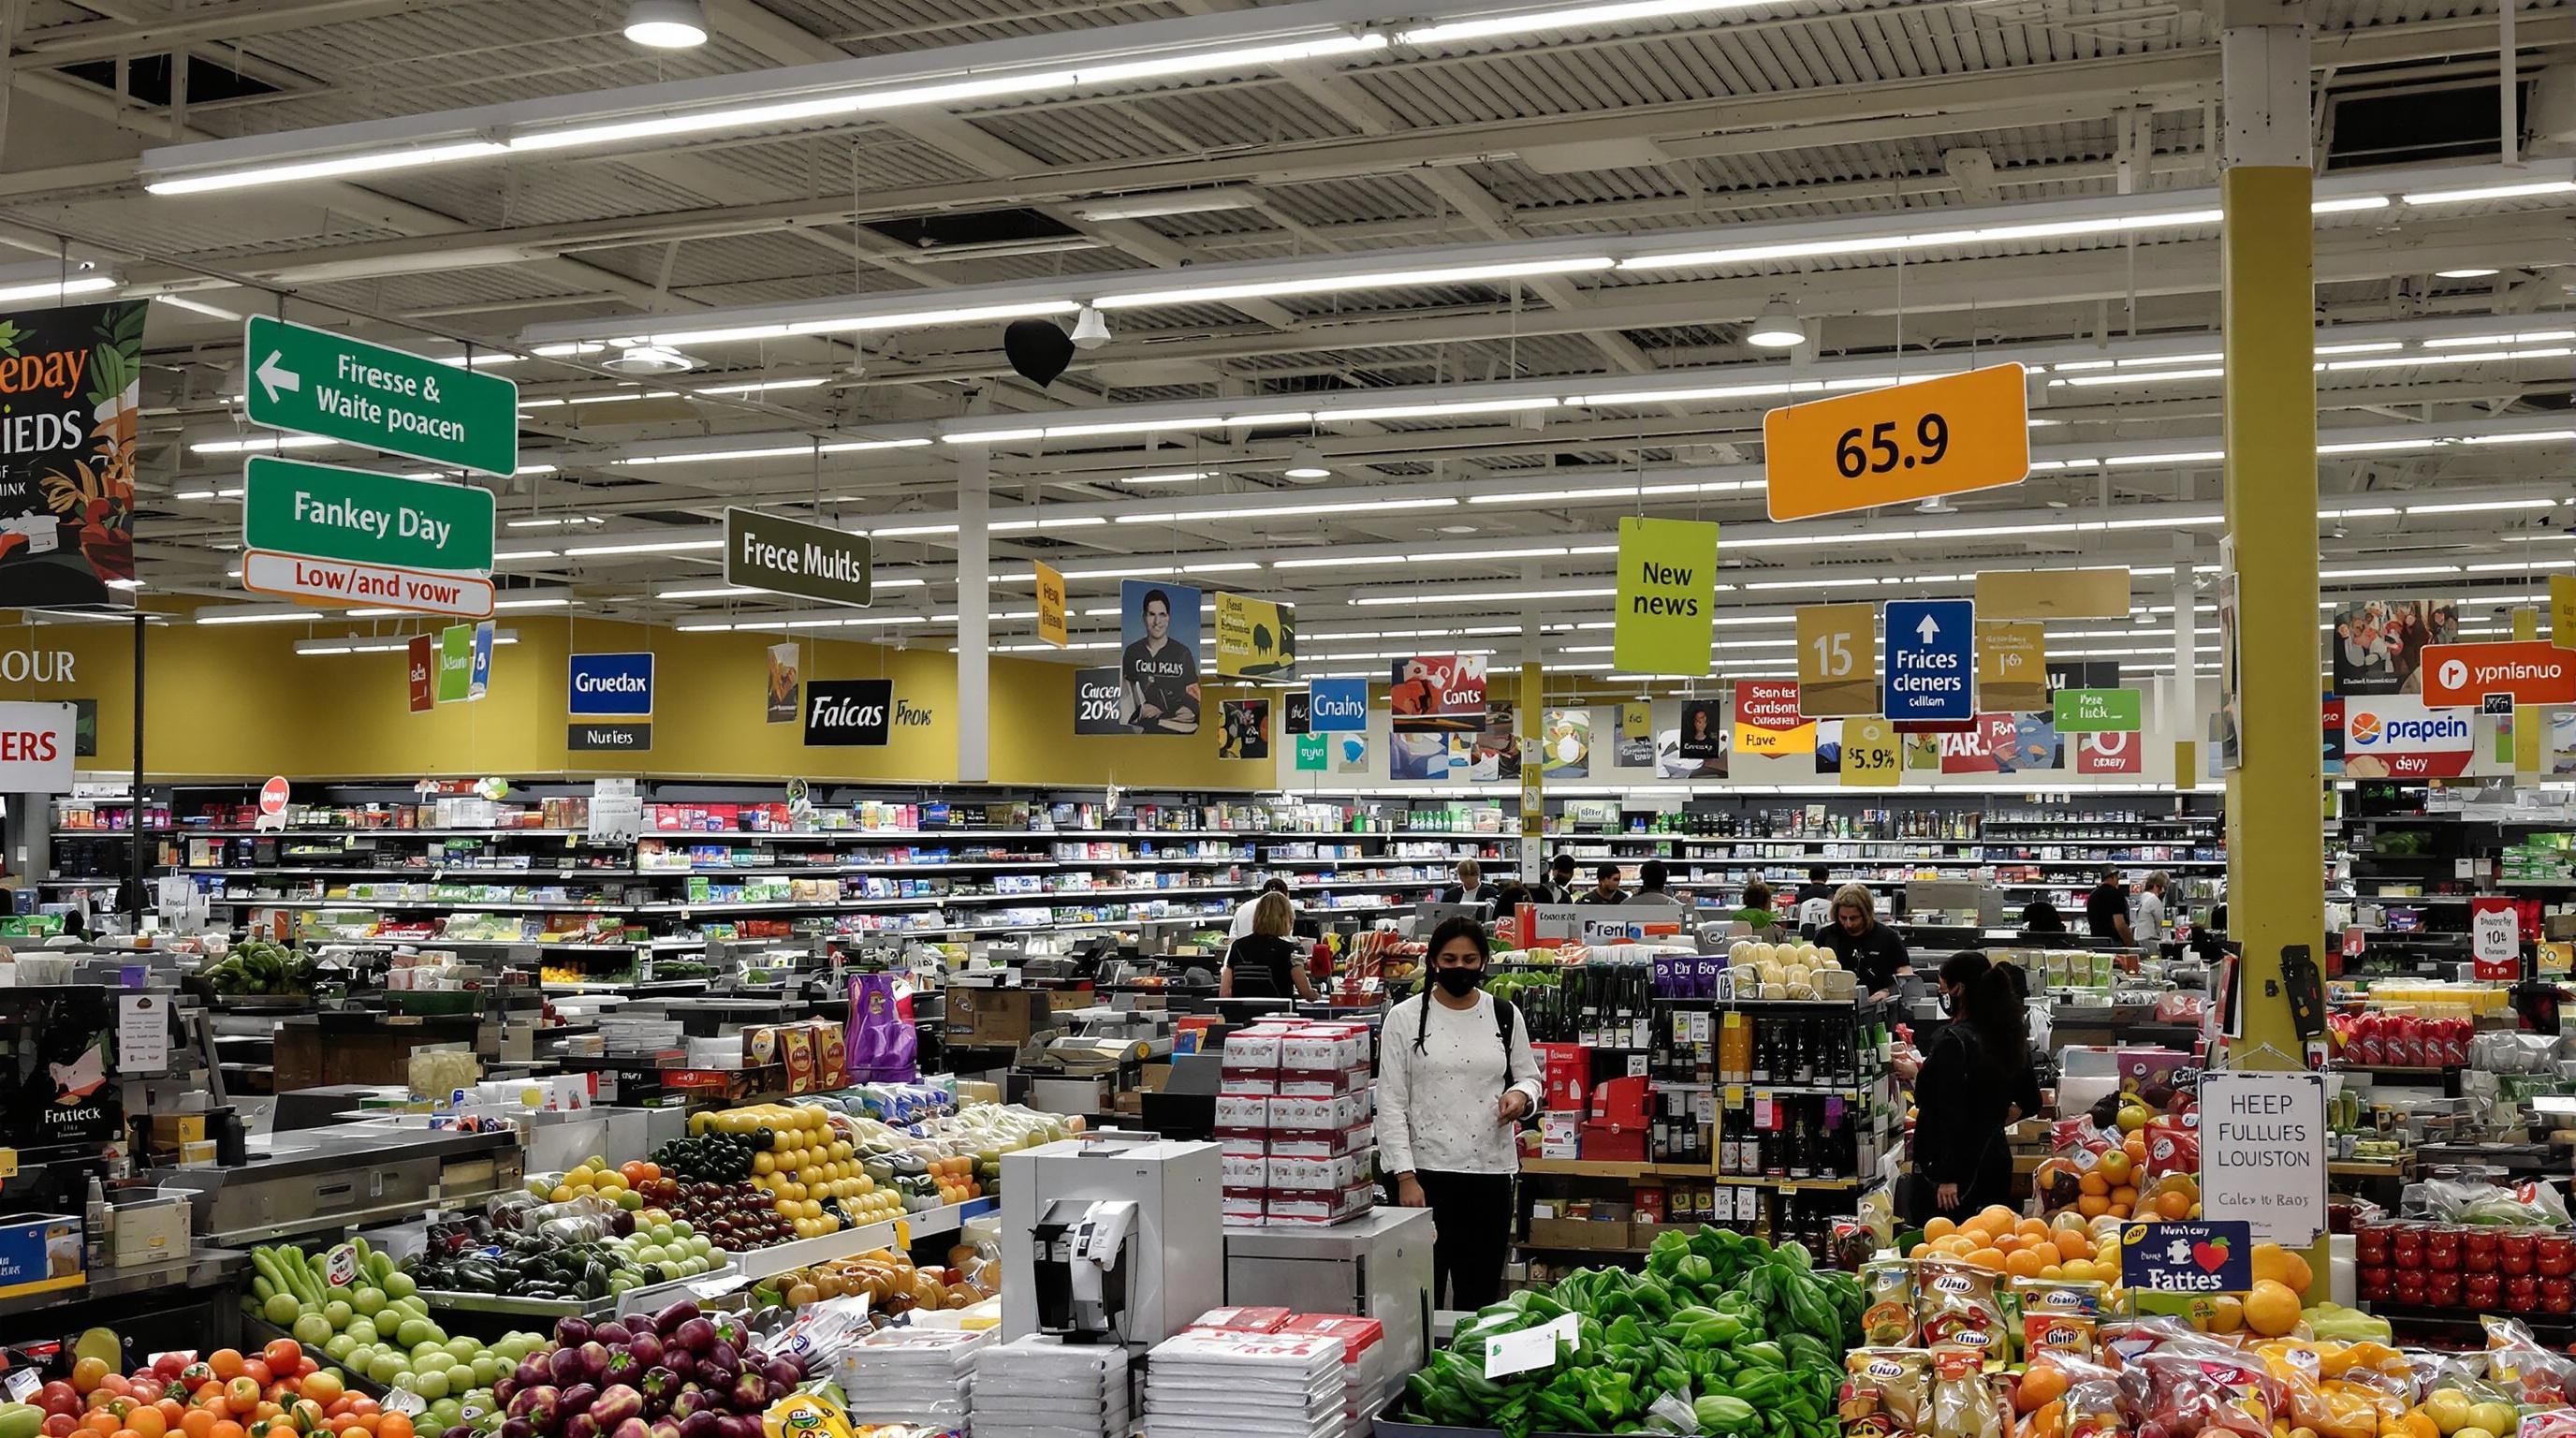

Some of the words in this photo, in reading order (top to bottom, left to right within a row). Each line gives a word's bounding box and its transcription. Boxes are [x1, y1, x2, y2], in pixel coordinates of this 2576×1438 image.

[338, 354, 417, 397] Firesse
[423, 376, 441, 404] &
[316, 385, 382, 424] Waite
[388, 407, 464, 443] poacen
[1837, 412, 1948, 478] 65.9
[295, 491, 390, 539] Fankey
[399, 506, 451, 550] Day
[744, 532, 798, 574] Frece
[1643, 562, 1693, 586] New
[1633, 595, 1698, 617] news
[0, 650, 76, 682] OUR
[1813, 632, 1853, 676] 15
[1443, 689, 1482, 705] Cants
[1894, 673, 1962, 692] cleners
[1080, 700, 1120, 720] 20%
[2387, 715, 2467, 744] prapein
[2, 731, 57, 762] ERS
[2231, 1094, 2292, 1115] HEEP
[2218, 1151, 2310, 1167] LOUISTON
[2147, 1269, 2222, 1291] Fattes
